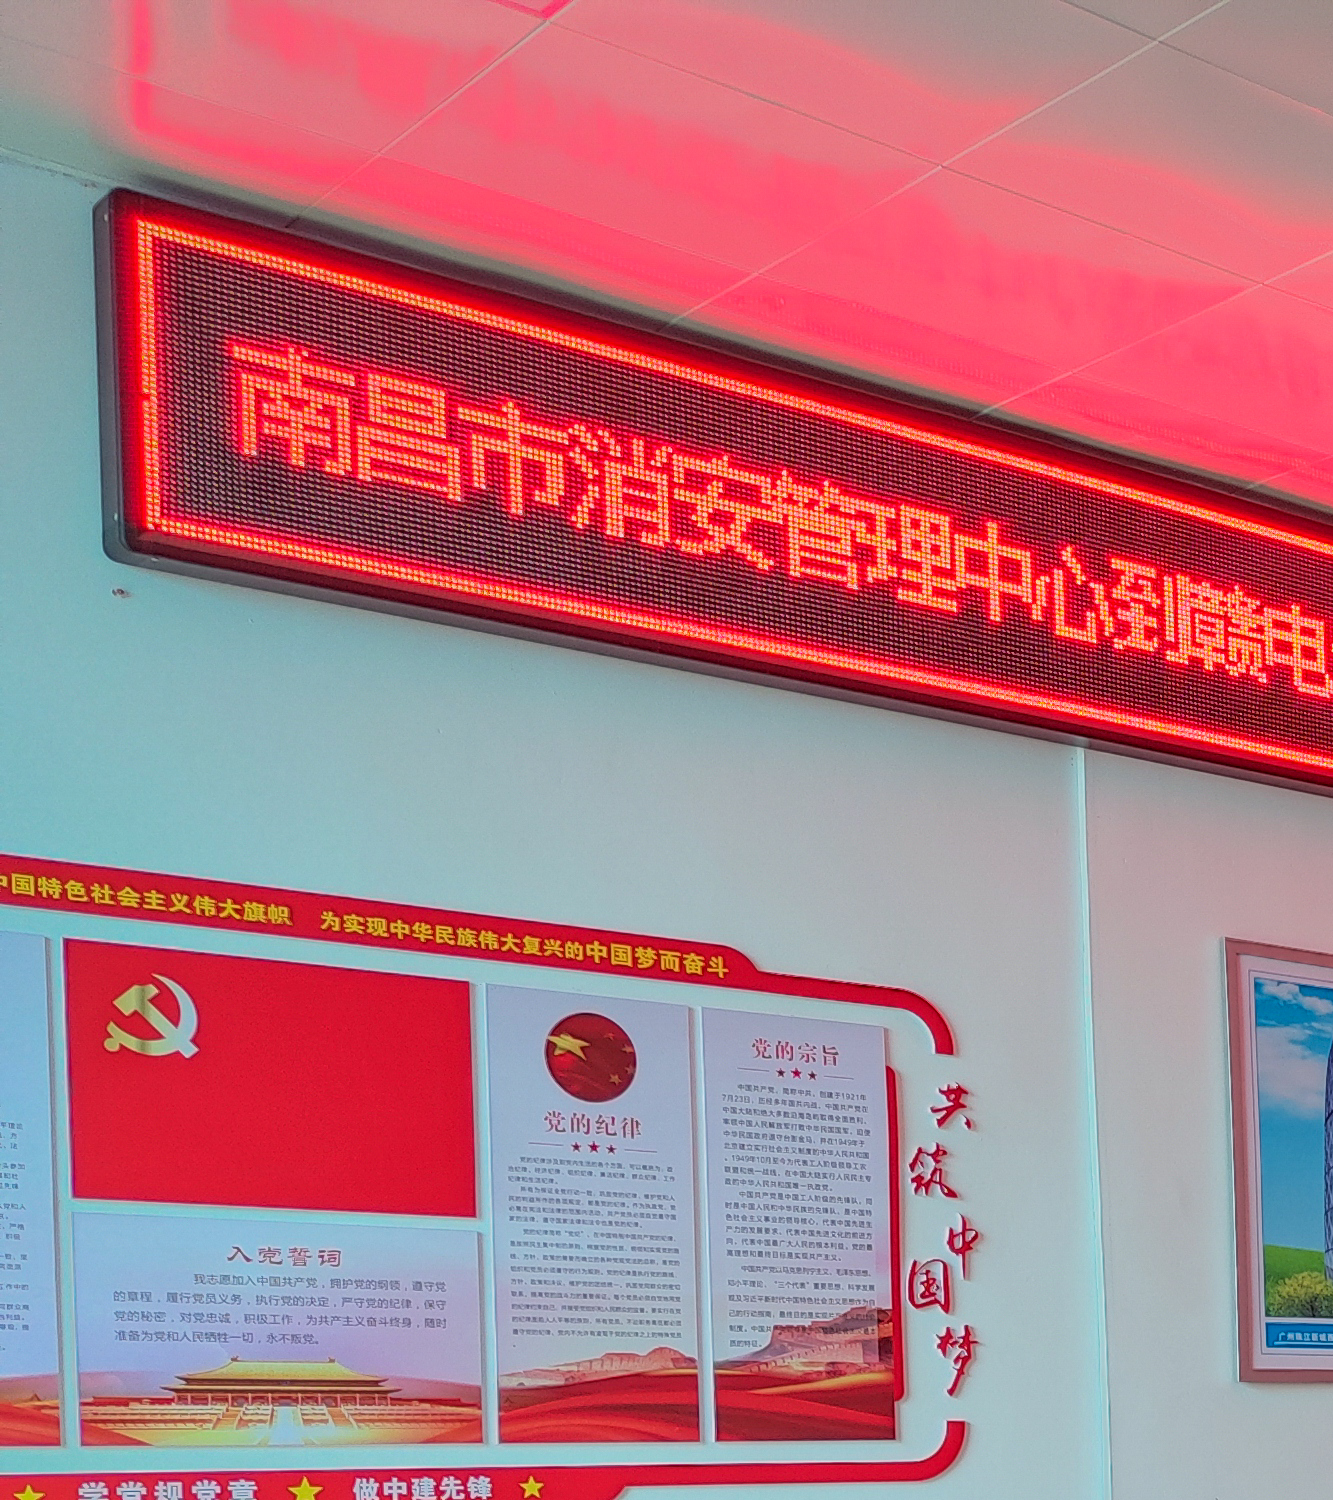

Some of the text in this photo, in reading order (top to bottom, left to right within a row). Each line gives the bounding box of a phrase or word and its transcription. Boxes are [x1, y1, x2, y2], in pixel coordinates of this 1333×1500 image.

[0, 872, 730, 979] 国特色社会主义伟大旗帜 为实现中华民族伟大复兴的中国梦而奋斗
[752, 1037, 839, 1067] 党的宗旨
[543, 1110, 642, 1139] 党的纪律
[905, 1081, 982, 1397] 共筑中国梦
[226, 1246, 343, 1268] 入党誓词
